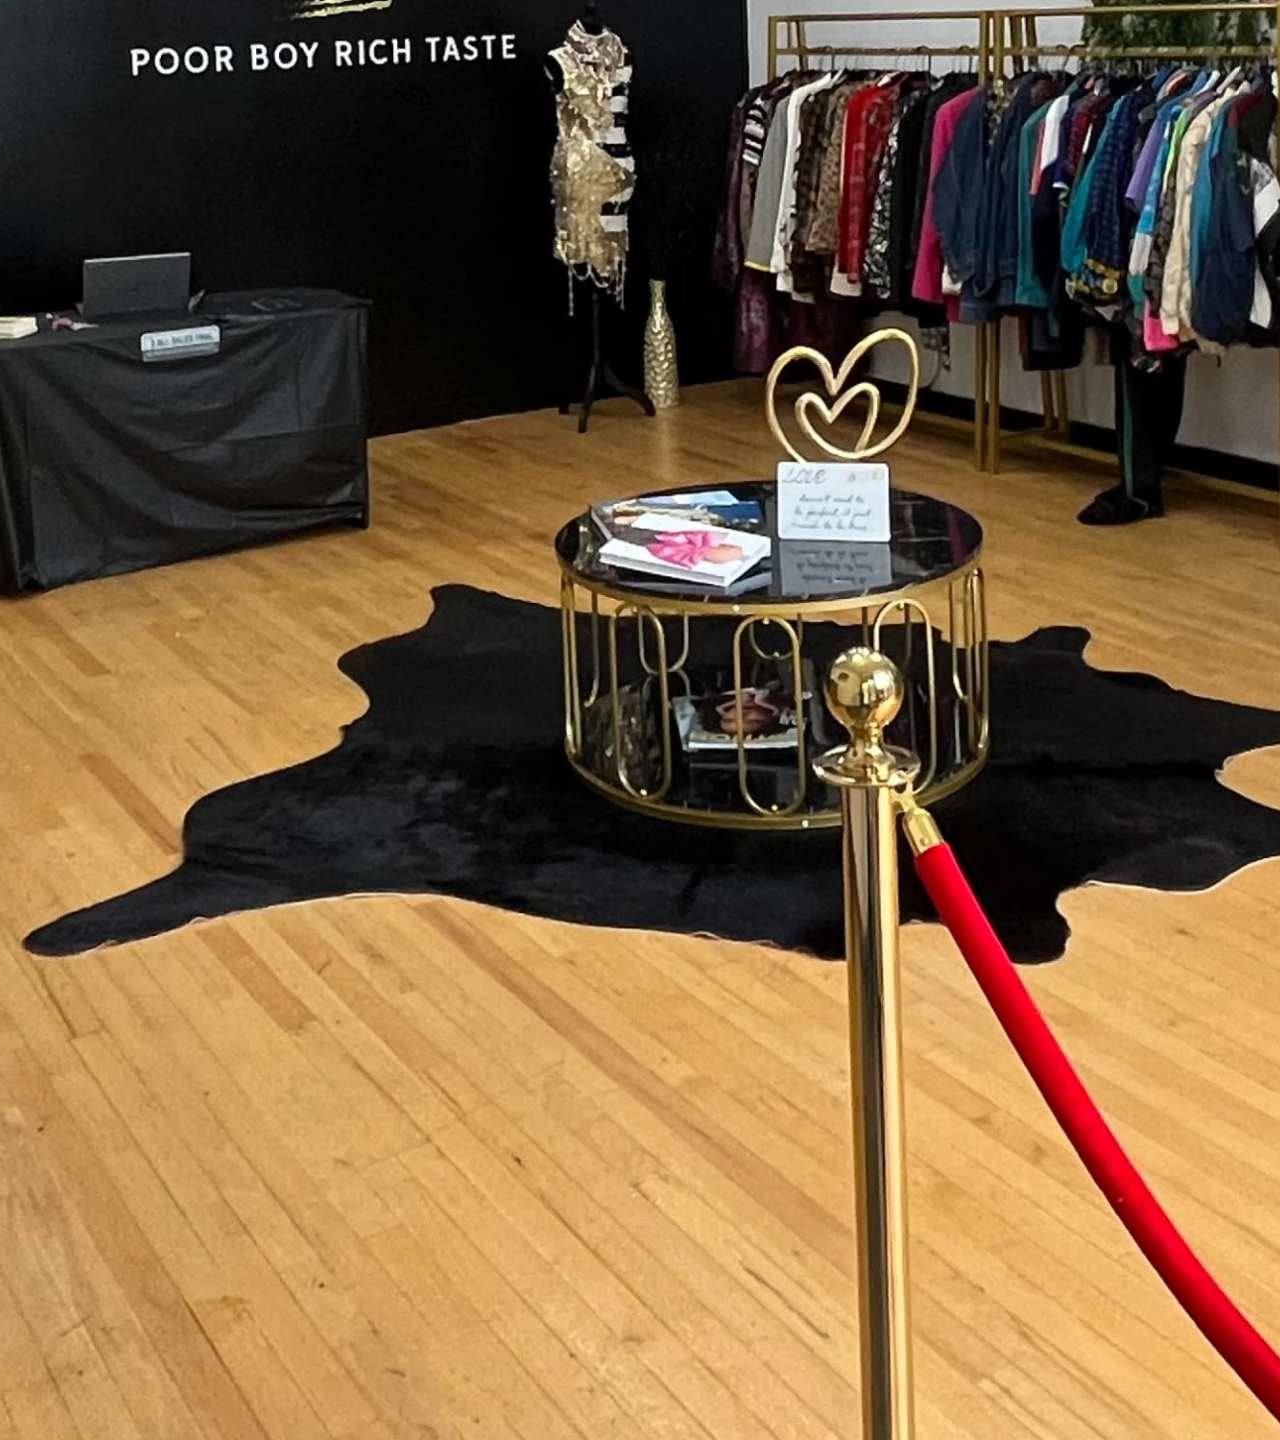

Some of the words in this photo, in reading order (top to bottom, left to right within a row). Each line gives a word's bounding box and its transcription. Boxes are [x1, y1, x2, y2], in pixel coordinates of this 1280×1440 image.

[130, 45, 234, 76] POOR
[249, 41, 319, 71] BOY
[334, 38, 411, 67] RICH
[424, 34, 517, 63] TASTE
